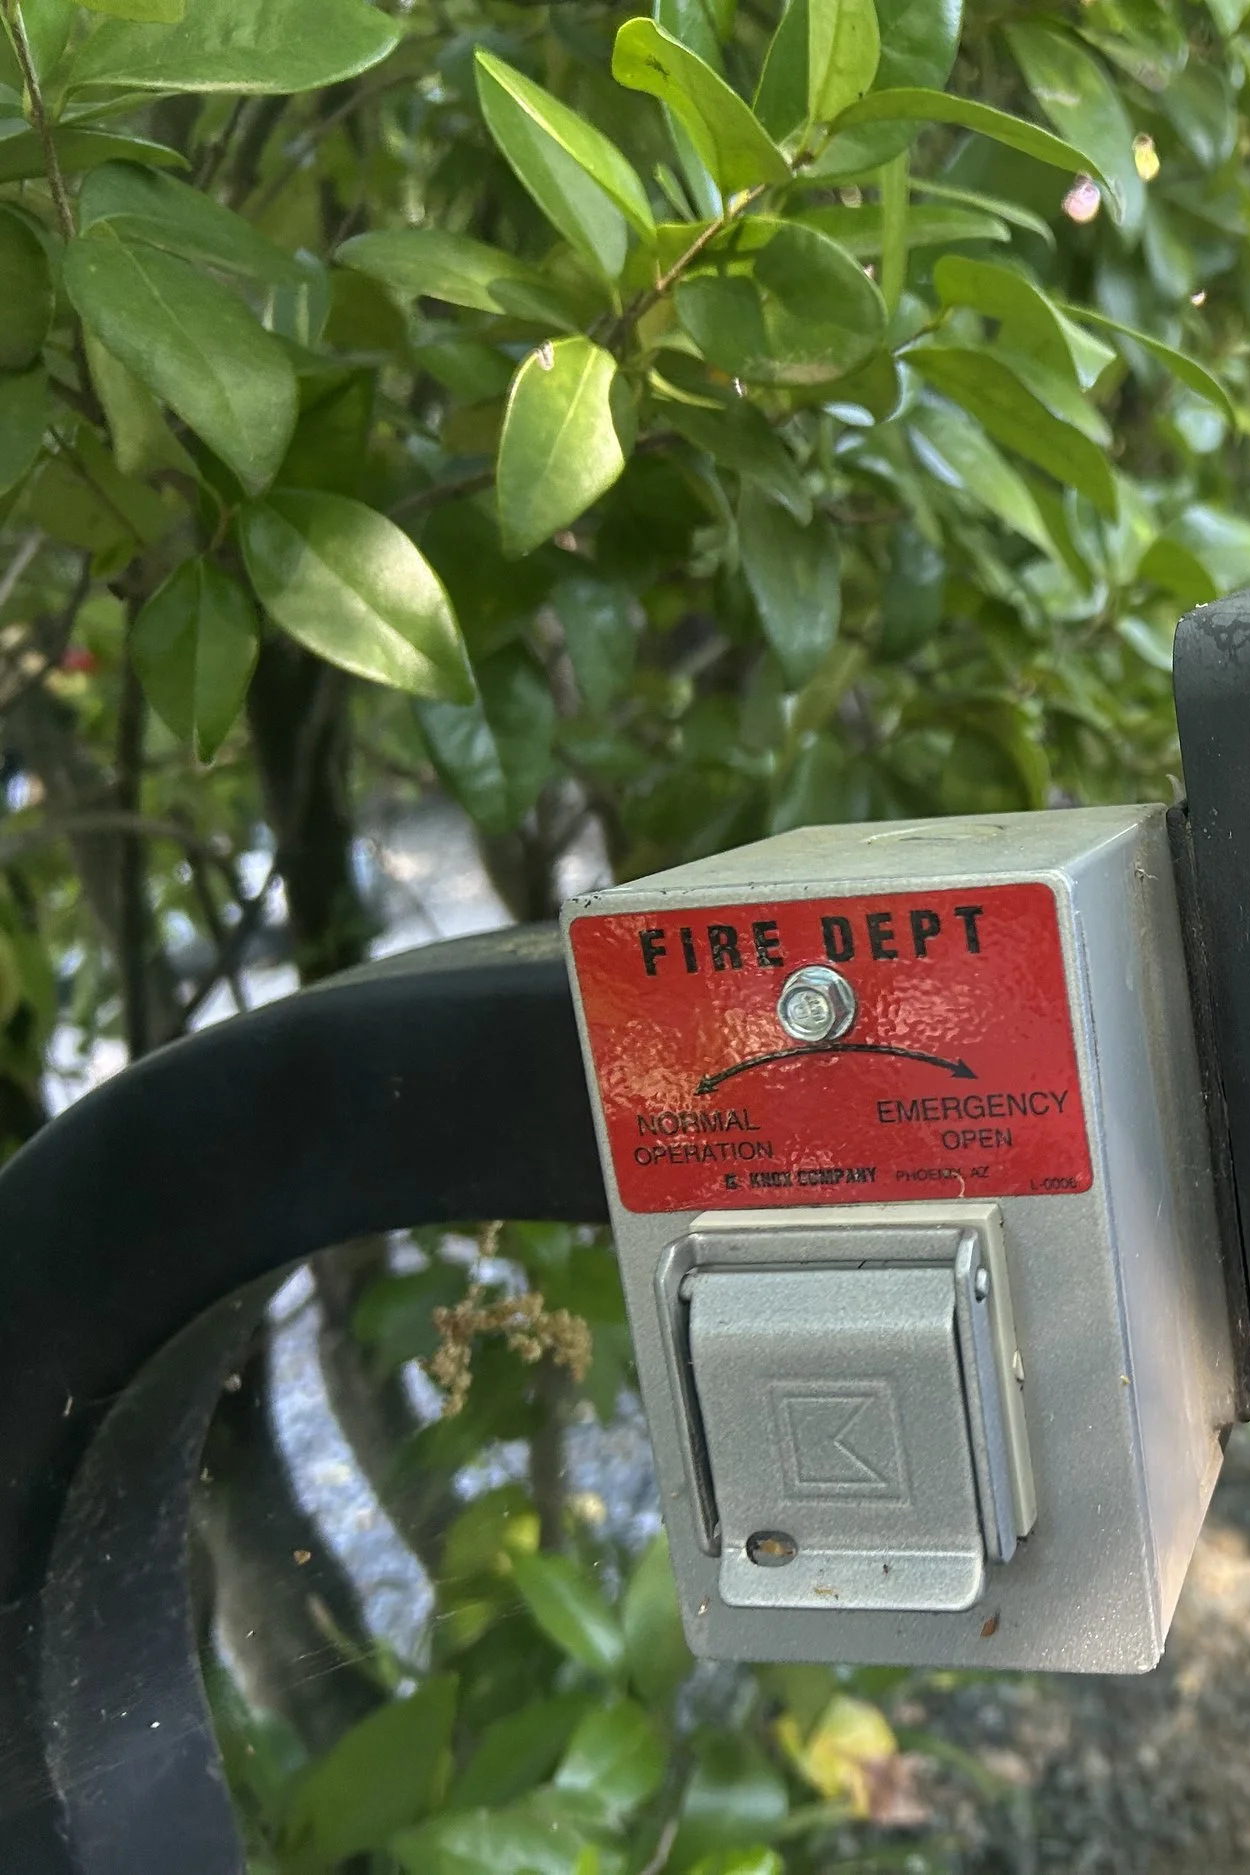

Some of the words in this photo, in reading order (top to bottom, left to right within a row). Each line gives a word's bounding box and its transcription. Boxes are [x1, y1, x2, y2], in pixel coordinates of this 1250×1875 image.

[639, 920, 784, 977] FIRE
[820, 905, 983, 963] DEPT
[877, 1091, 1069, 1124] EMERGENCY
[637, 1109, 760, 1136] NORMAL
[942, 1128, 1013, 1151] OPEN
[634, 1141, 773, 1166] OPERATION
[797, 1167, 876, 1186] COMPANY
